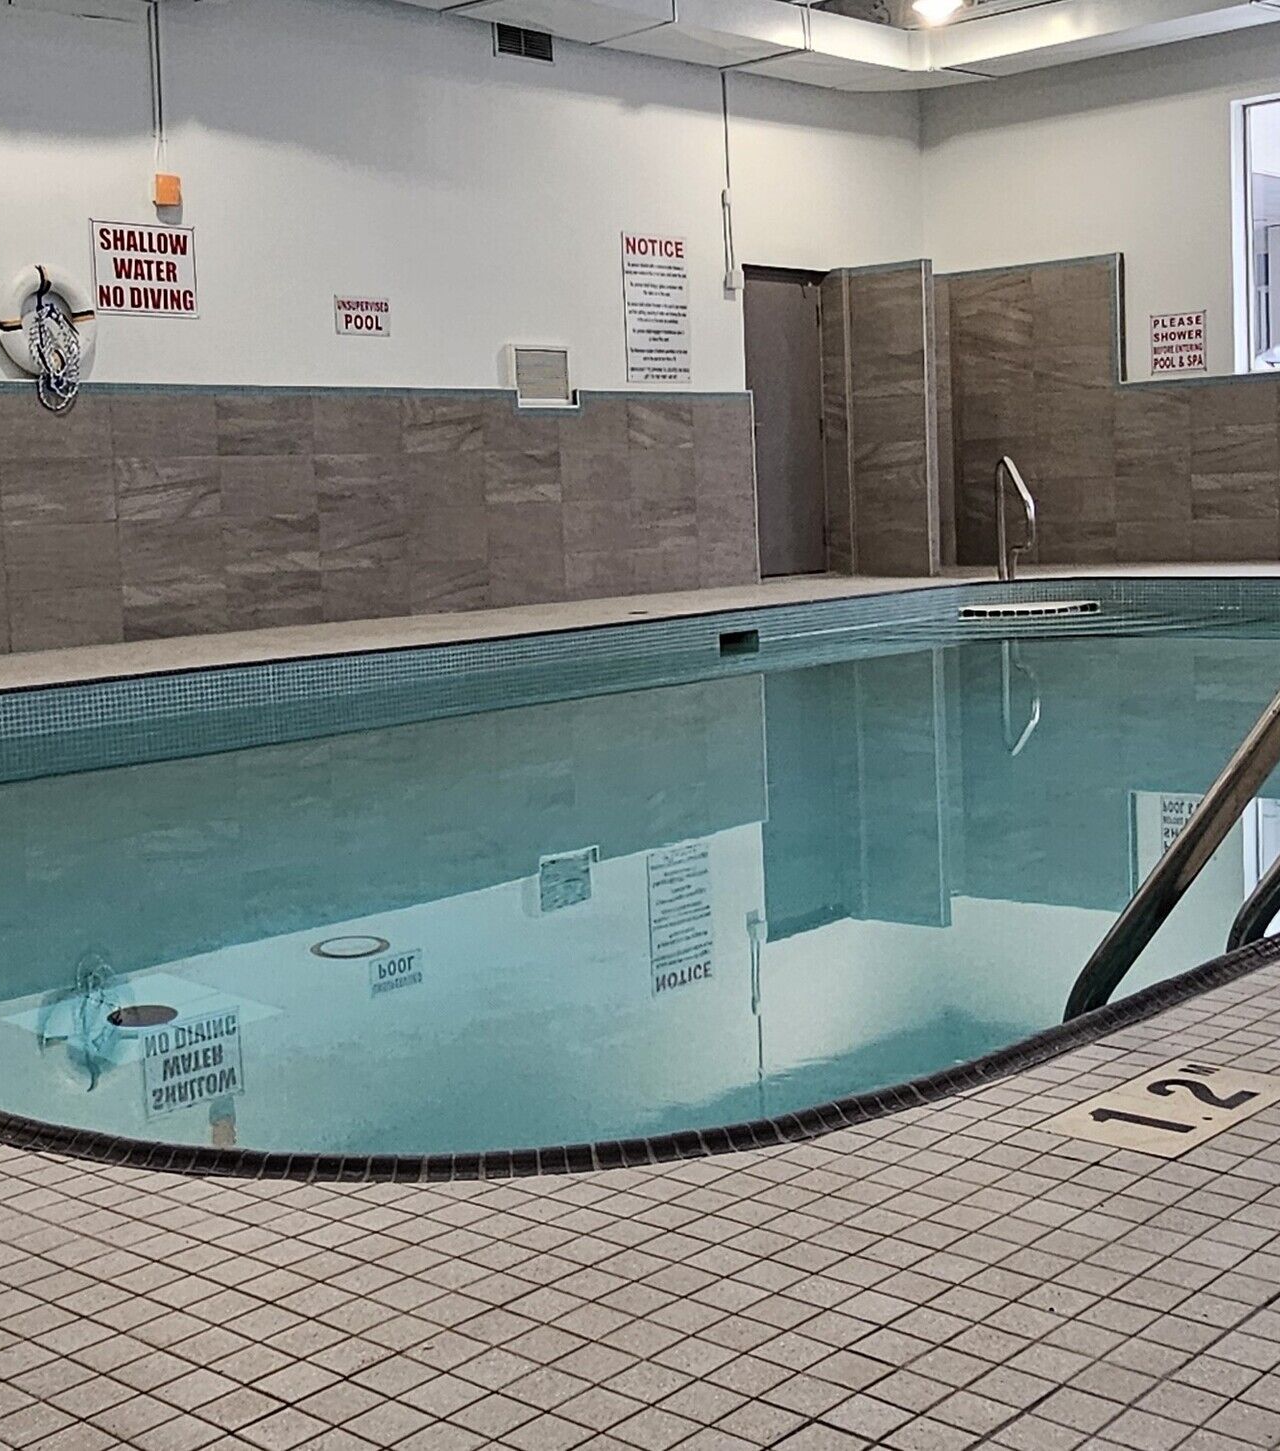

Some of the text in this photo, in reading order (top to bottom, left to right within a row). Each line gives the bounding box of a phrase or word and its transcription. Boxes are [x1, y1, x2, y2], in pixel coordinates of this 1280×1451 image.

[99, 228, 188, 256] SHALLOW
[625, 236, 684, 259] NOTICE
[113, 257, 178, 283] WATER
[99, 285, 195, 312] NO DIVING
[344, 313, 383, 331] POOL
[1153, 315, 1202, 329] PLEASE
[1153, 329, 1202, 343] SHOWER
[1153, 354, 1203, 370] POOL & SPA
